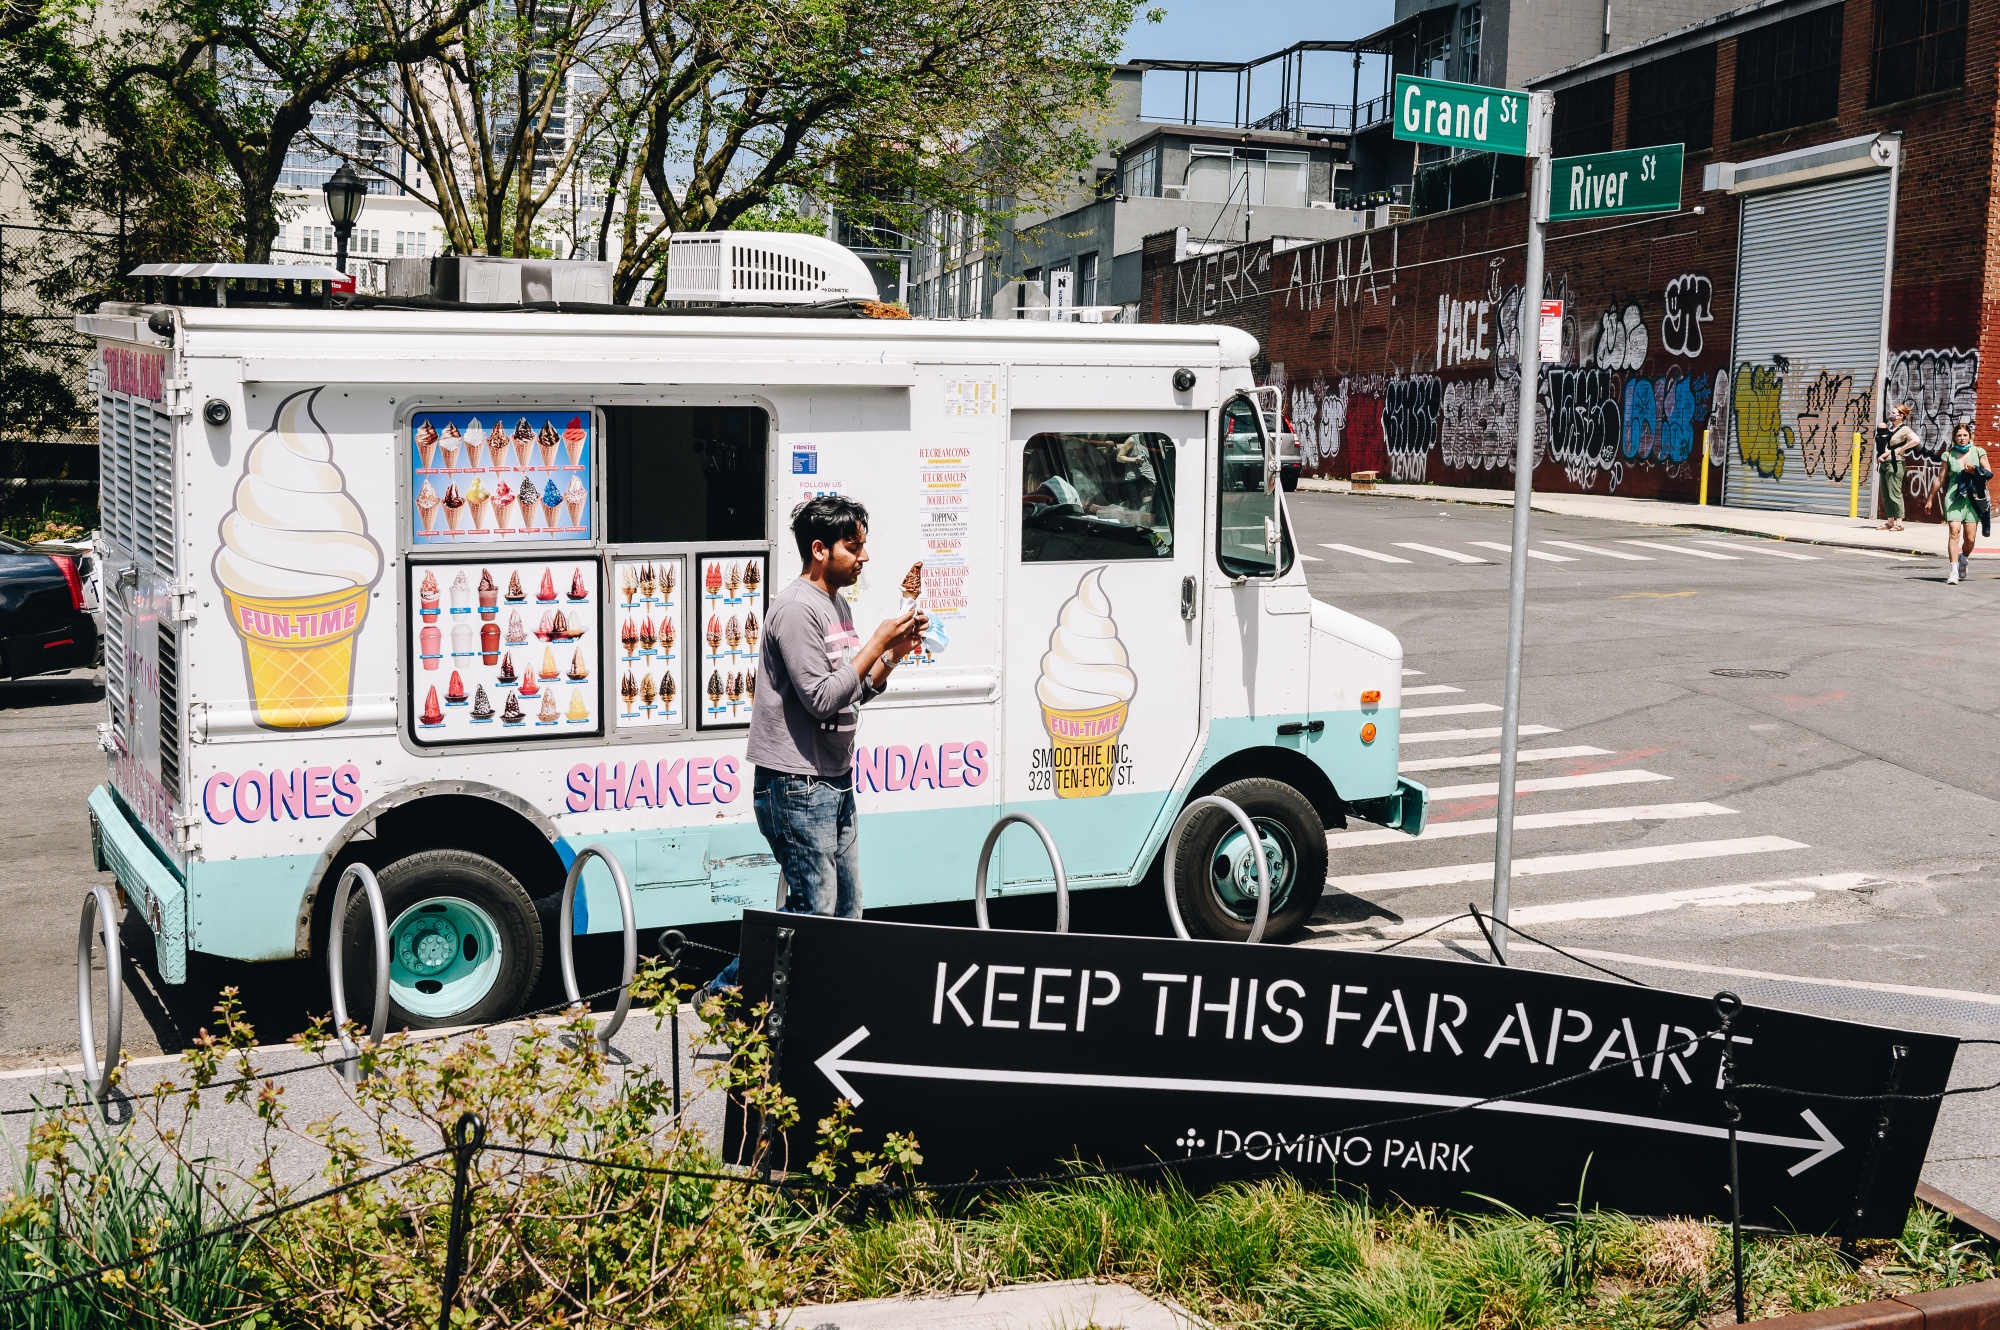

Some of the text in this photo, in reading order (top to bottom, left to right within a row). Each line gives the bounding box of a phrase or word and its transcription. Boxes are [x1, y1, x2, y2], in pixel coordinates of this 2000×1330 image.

[1403, 85, 1518, 141] Grand St
[1569, 154, 1657, 211] River St
[1175, 246, 1261, 323] MERK
[931, 512, 958, 523] TOPPINGS
[927, 539, 962, 549] MILKSHAKES
[924, 576, 964, 588] SHAKE FLOATS
[934, 567, 950, 577] SHAKE
[951, 566, 970, 577] FLOATS
[239, 602, 358, 639] FUN-TIME
[1050, 712, 1121, 738] FUN-TIME
[850, 740, 989, 794] NDAES
[1032, 743, 1133, 769] SMOOTHIE INC.
[202, 764, 363, 826] CONES
[566, 755, 741, 813] SHAKES
[1028, 770, 1051, 791] 328
[1117, 765, 1135, 786] ST.
[932, 961, 1754, 1090] KEEP THIS FAR APART
[1215, 1129, 1474, 1173] DOMINO PARK
